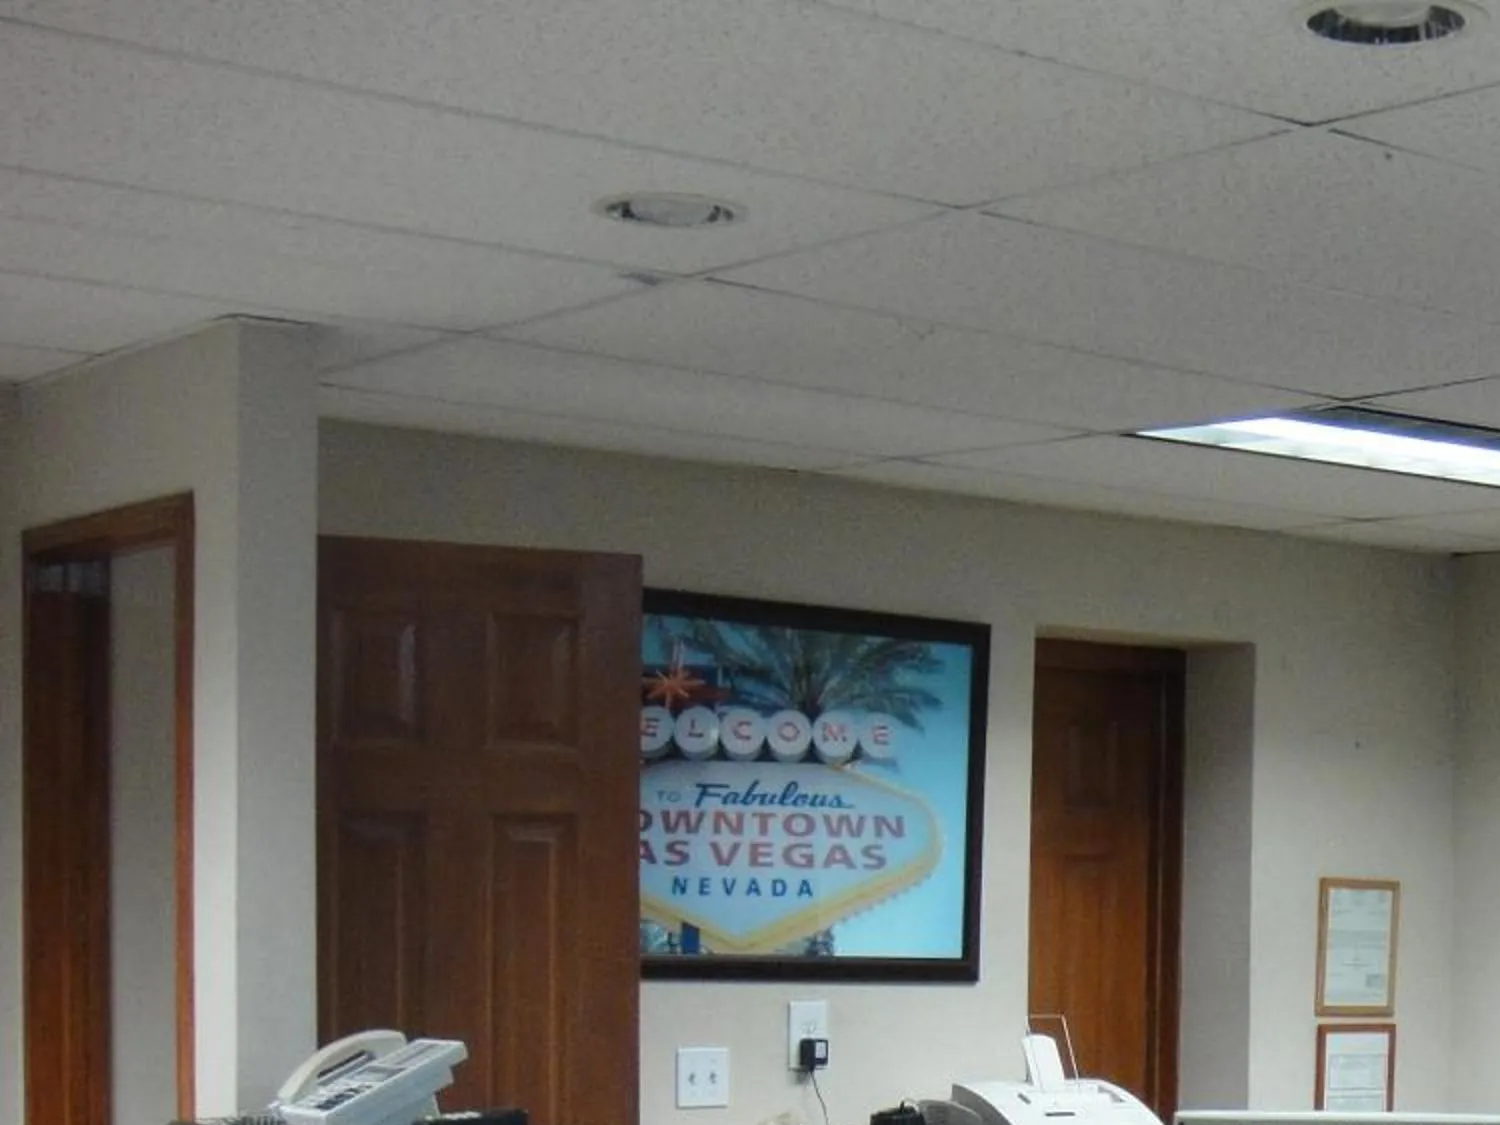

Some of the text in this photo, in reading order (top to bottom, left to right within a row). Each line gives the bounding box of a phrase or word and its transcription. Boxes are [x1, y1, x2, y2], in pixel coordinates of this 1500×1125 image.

[641, 717, 892, 746] ELCOME
[656, 779, 856, 809] TO Fabulous
[640, 810, 906, 838] WNTOWN
[640, 840, 888, 870] AS VEGAS
[671, 877, 814, 897] NEVADA
